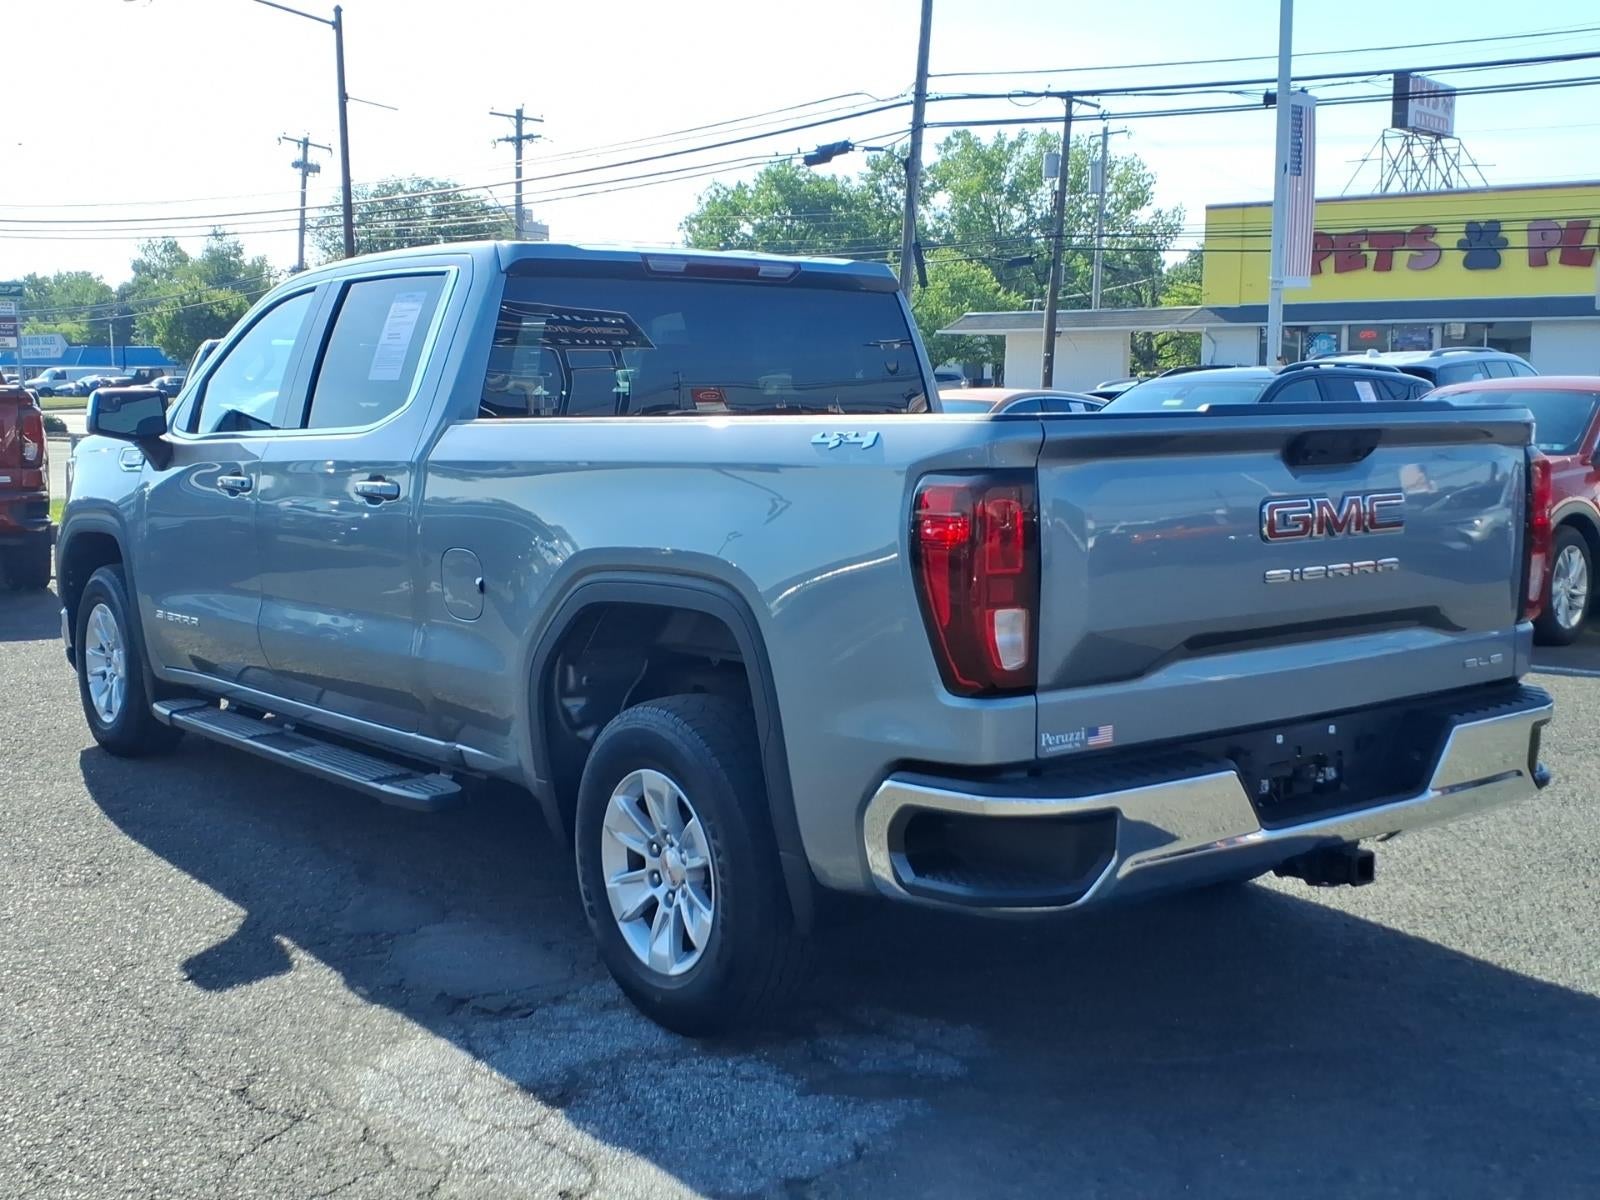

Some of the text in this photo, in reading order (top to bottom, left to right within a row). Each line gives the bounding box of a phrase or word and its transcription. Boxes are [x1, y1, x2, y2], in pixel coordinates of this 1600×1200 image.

[1311, 219, 1600, 275] PETS PL
[1260, 490, 1405, 542] GMC
[1264, 557, 1399, 584] SIERRA
[155, 609, 199, 626] SIERRA
[1464, 653, 1503, 668] SLE
[1041, 727, 1085, 746] Peruzzi
